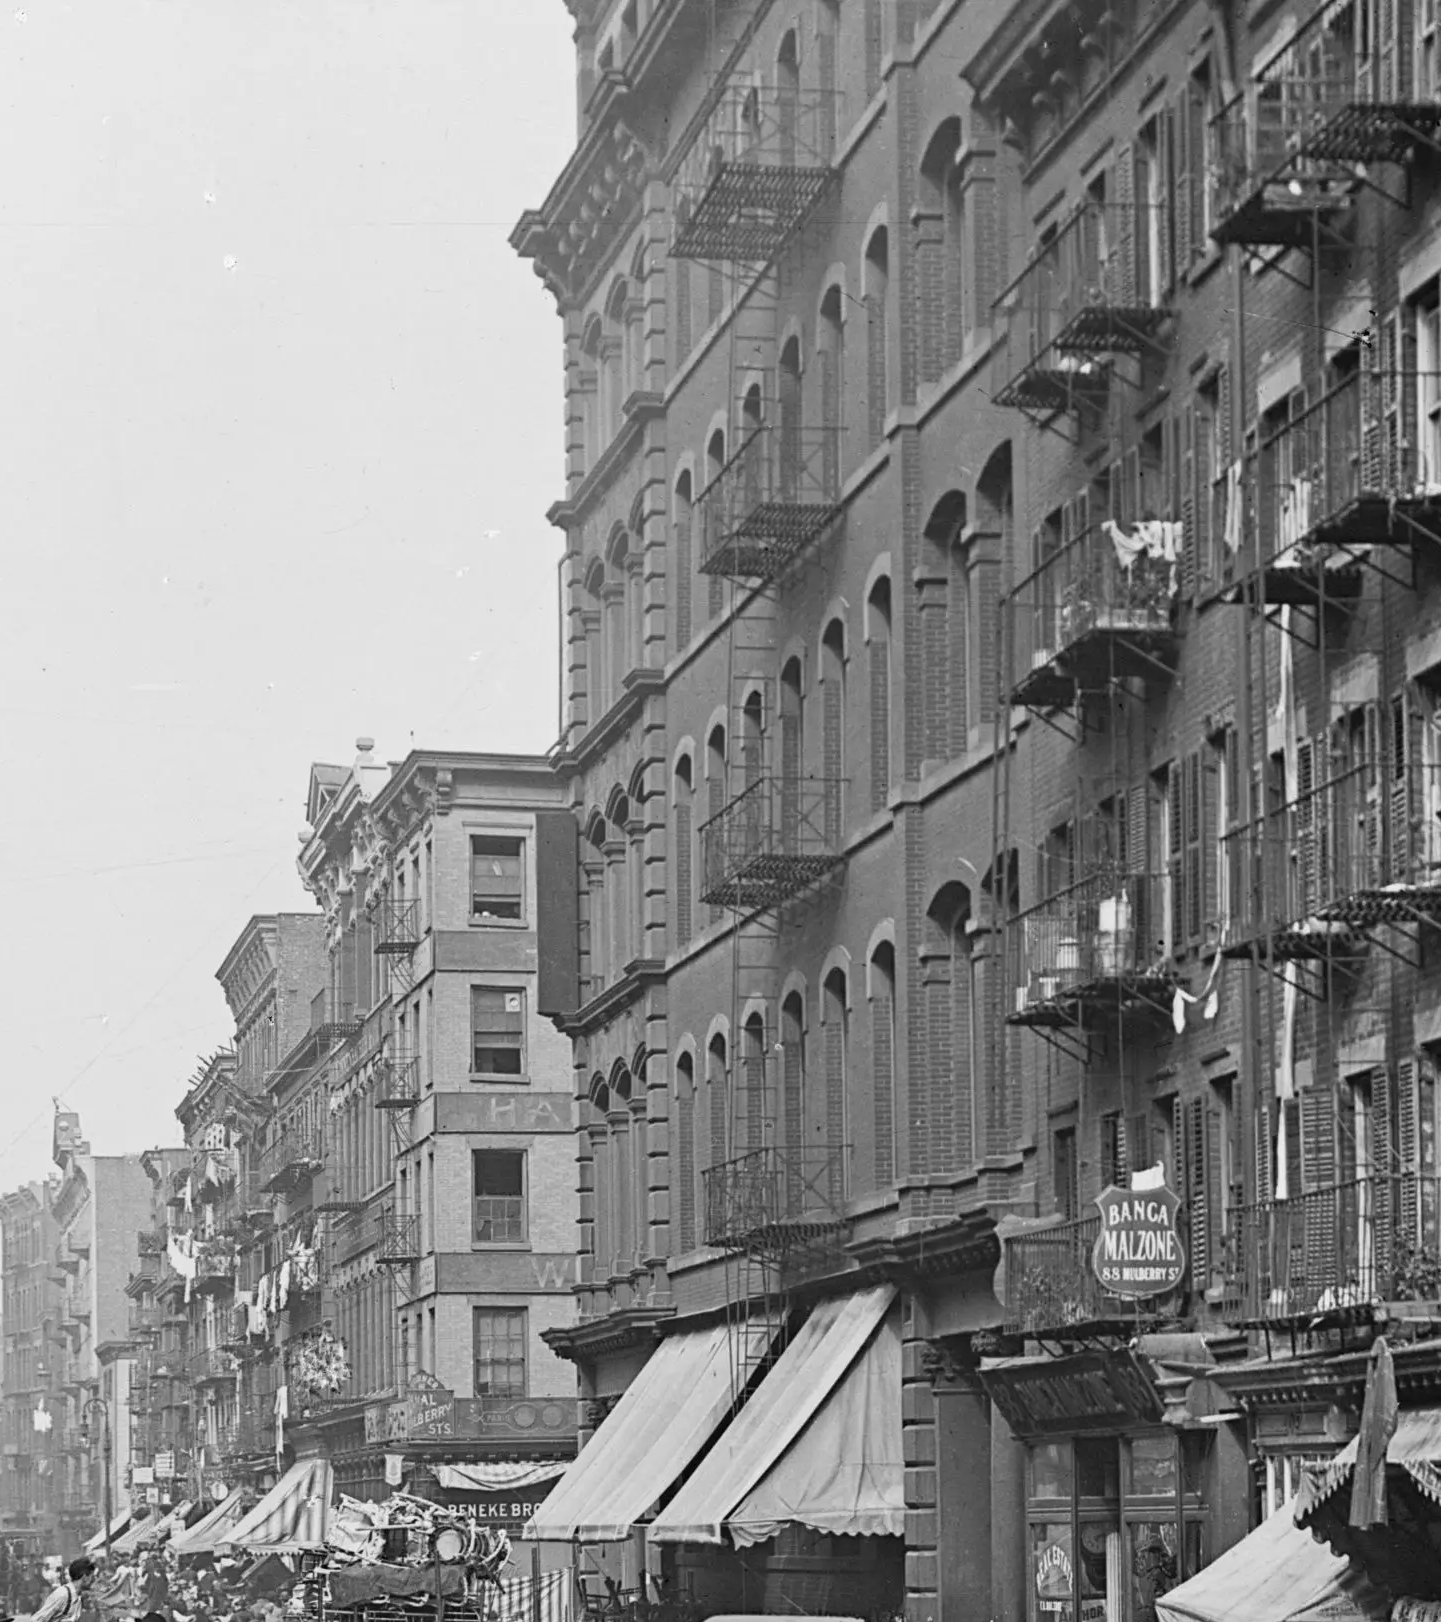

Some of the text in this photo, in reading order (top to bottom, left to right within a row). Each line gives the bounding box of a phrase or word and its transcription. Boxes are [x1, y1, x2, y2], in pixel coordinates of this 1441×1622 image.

[1109, 1200, 1169, 1226] BANCA
[1104, 1230, 1176, 1261] MALZONE
[1102, 1266, 1120, 1281] 88
[1122, 1267, 1166, 1281] MULBERRY
[448, 1503, 508, 1517] BENEKE
[1036, 1548, 1053, 1593] REAL
